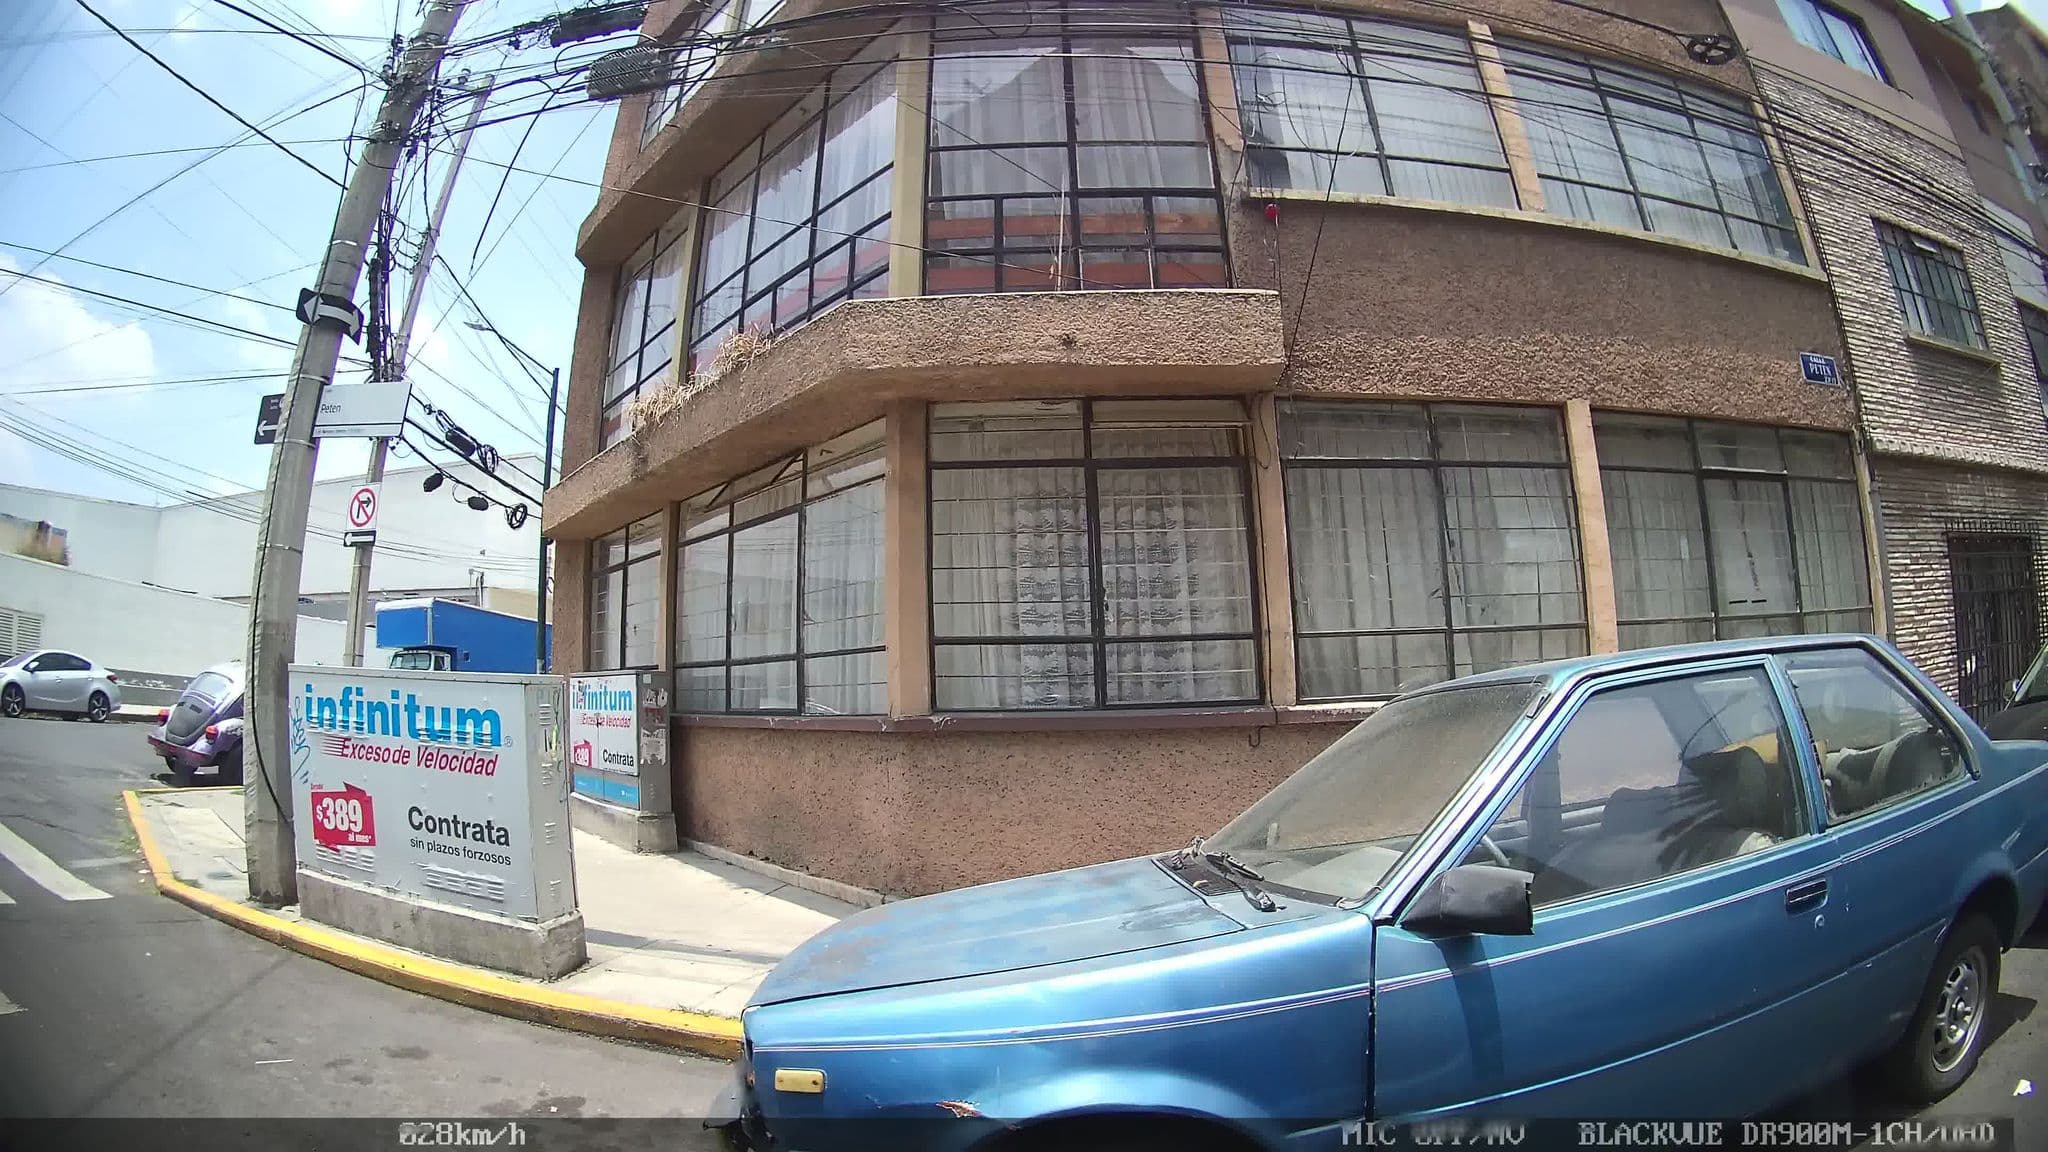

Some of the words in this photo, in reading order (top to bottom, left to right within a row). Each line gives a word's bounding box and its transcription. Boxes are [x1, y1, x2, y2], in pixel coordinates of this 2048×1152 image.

[305, 684, 502, 748] infinitum
[341, 737, 391, 763] Exceso
[392, 745, 411, 765] de
[416, 746, 499, 777] Velocidad
[602, 749, 635, 767] Contrata
[316, 797, 363, 832] $389
[408, 806, 511, 848] Contrata
[410, 837, 425, 850] sin
[427, 839, 461, 857] plazos
[463, 844, 512, 866] forzosos
